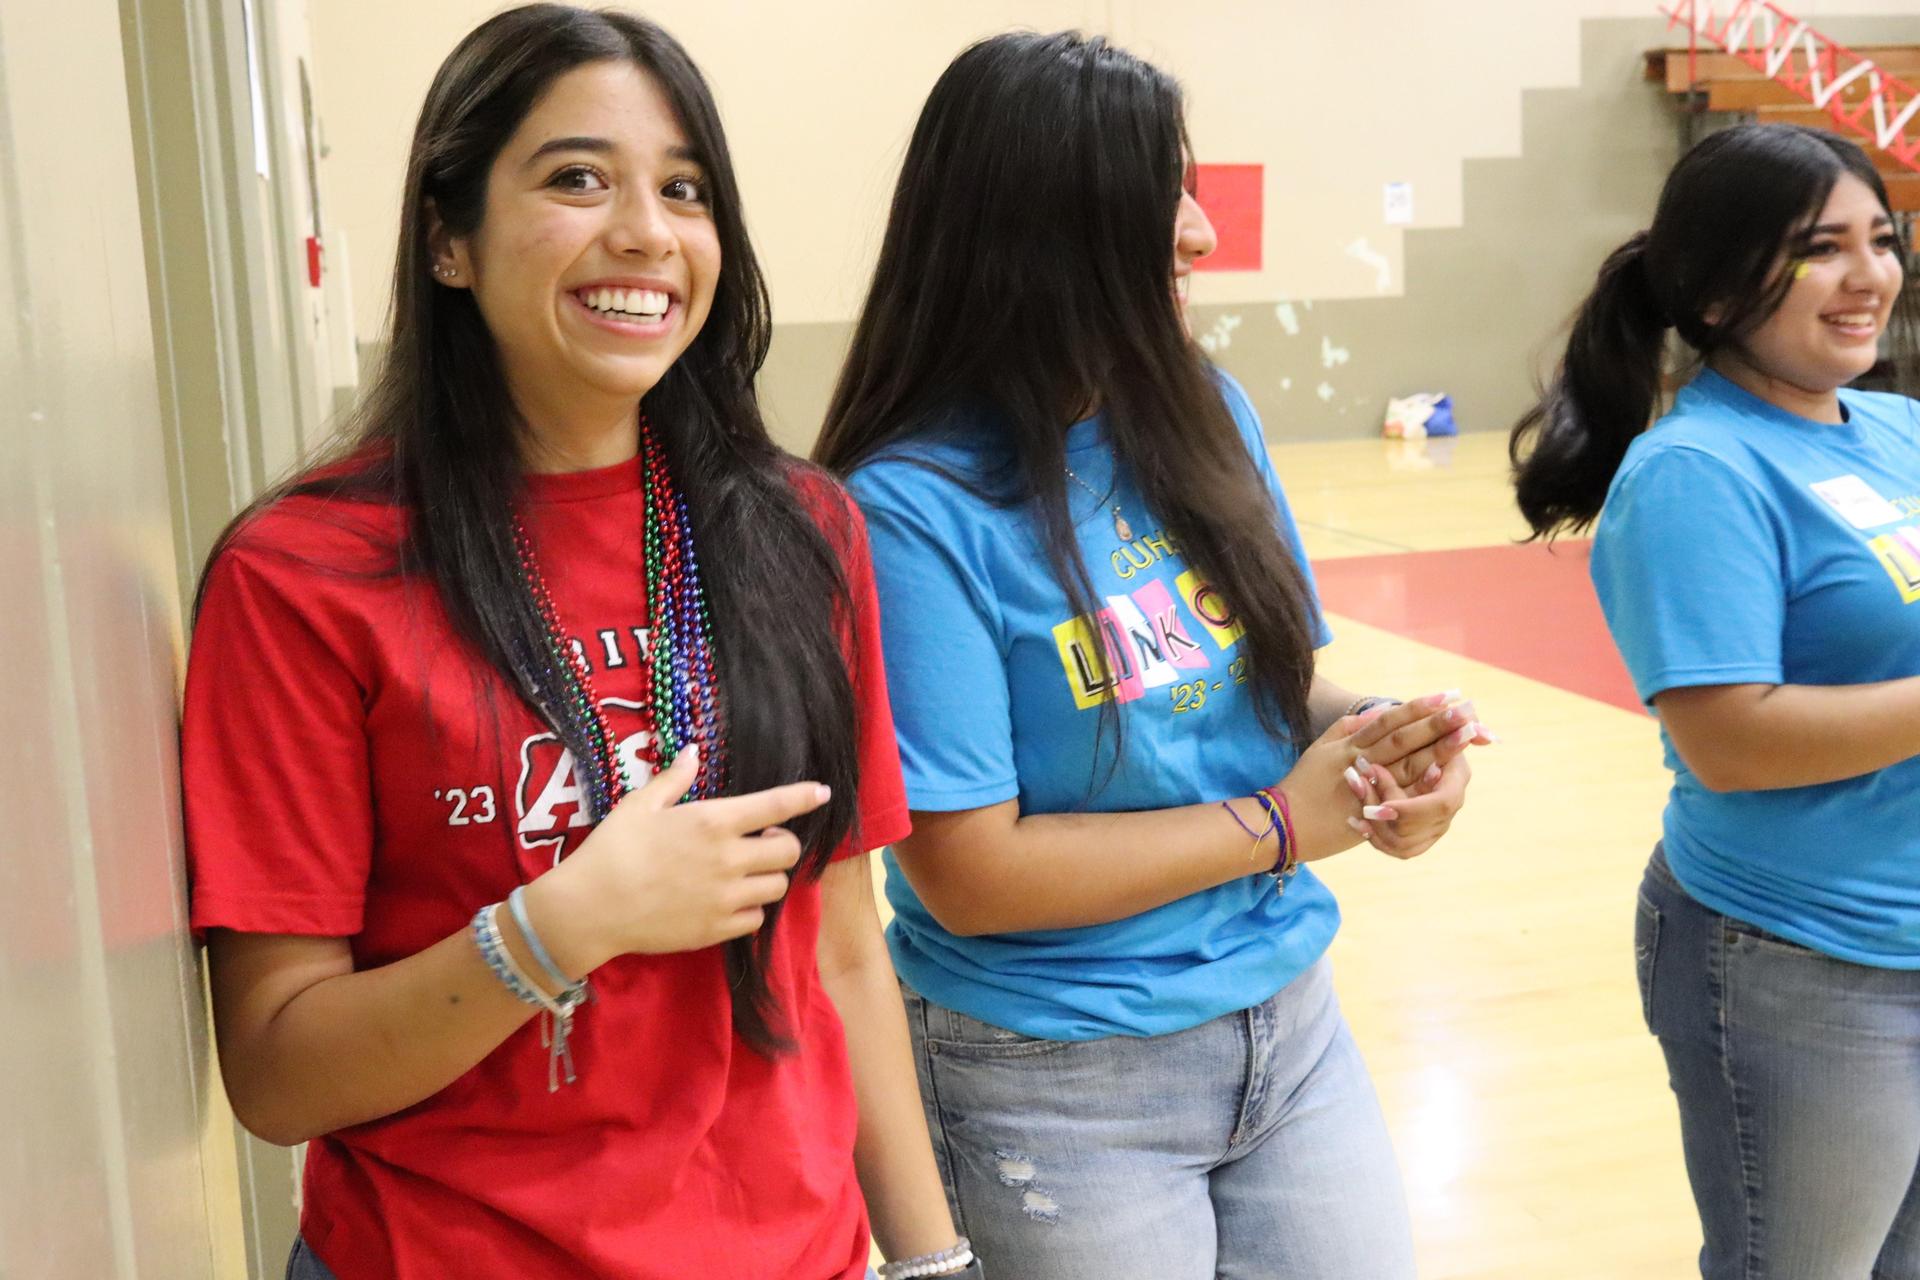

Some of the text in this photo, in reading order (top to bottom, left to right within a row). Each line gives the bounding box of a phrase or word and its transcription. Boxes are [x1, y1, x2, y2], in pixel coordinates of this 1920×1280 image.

[1110, 529, 1178, 580] CUH
[1065, 604, 1200, 697] LINK
[1169, 678, 1207, 714] '23
[1228, 656, 1247, 685] '2
[434, 785, 496, 826] '23
